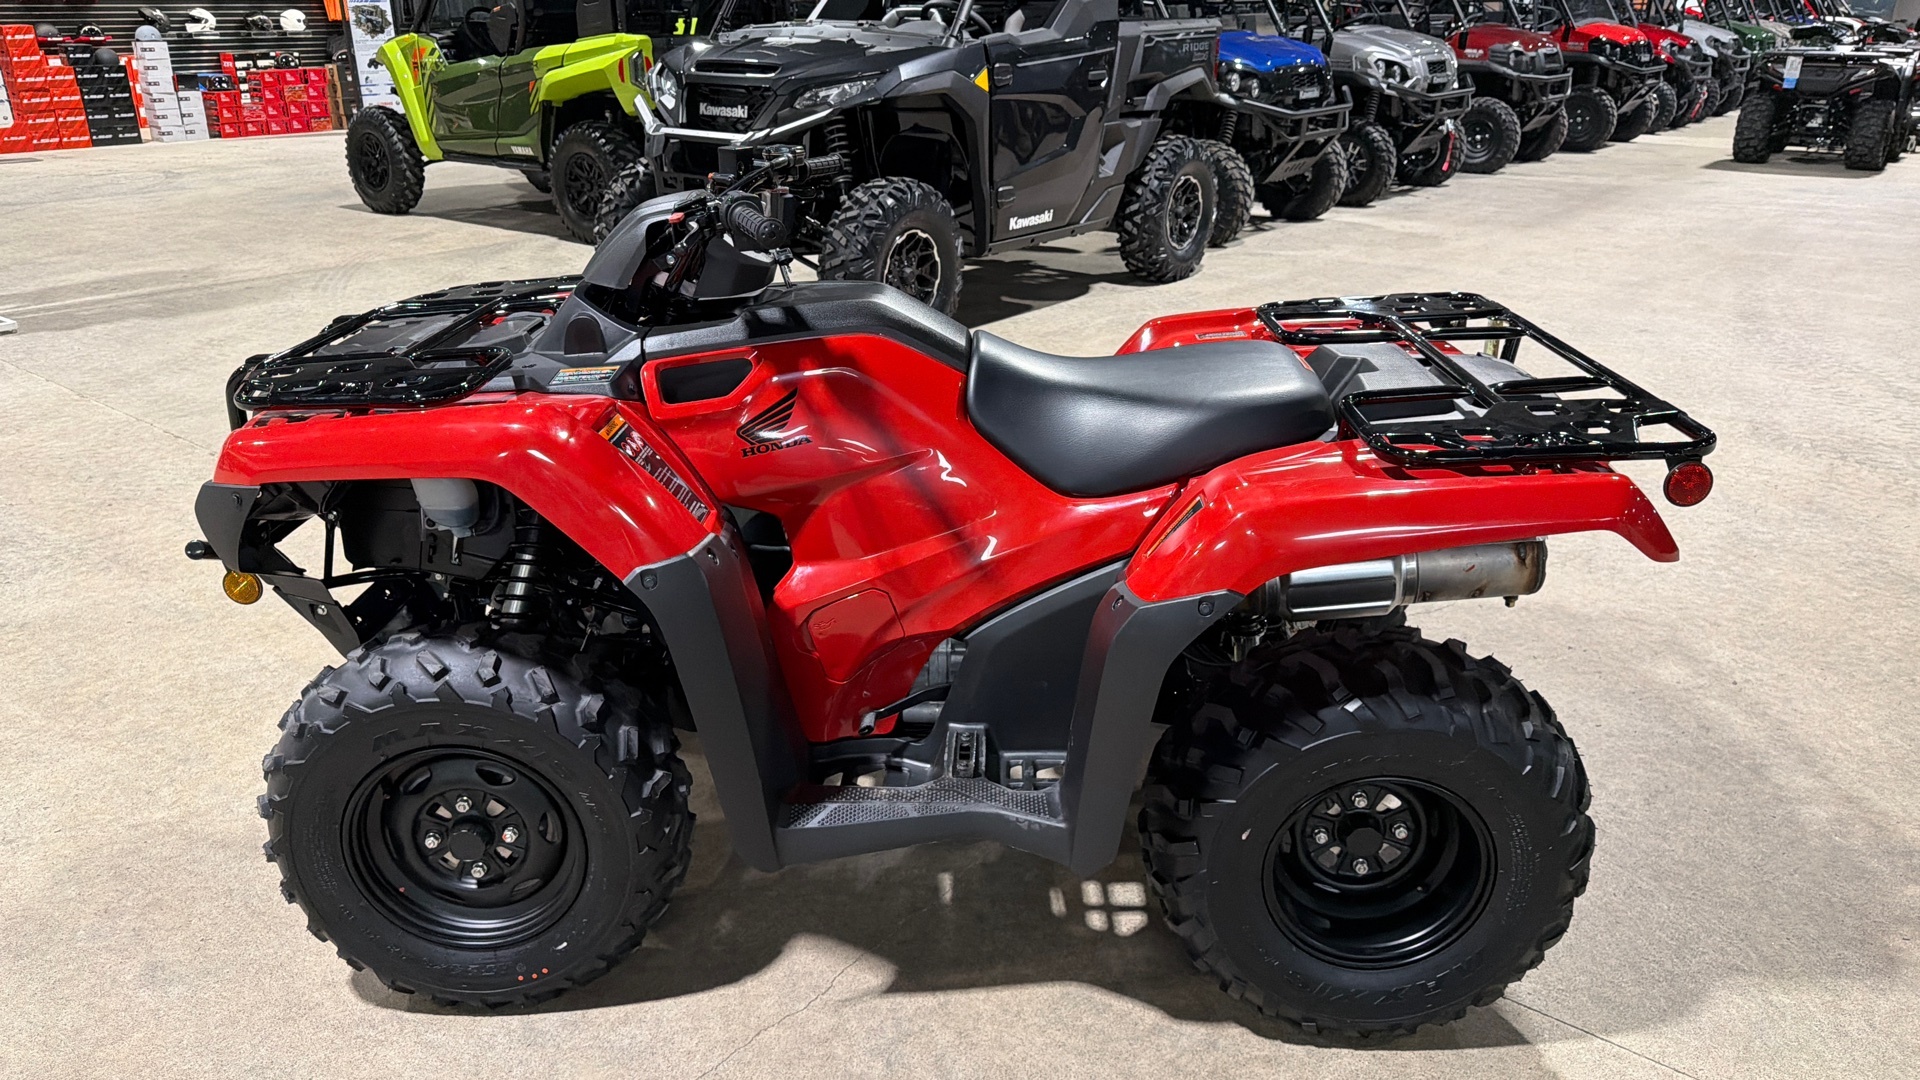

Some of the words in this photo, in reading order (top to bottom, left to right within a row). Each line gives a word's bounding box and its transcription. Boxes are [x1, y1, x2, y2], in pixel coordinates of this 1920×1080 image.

[1183, 41, 1209, 52] RIDGE
[699, 102, 748, 118] Kawasaki
[511, 145, 534, 155] YAMAHA
[1009, 208, 1054, 230] Kawasaki
[741, 436, 812, 458] HONDA
